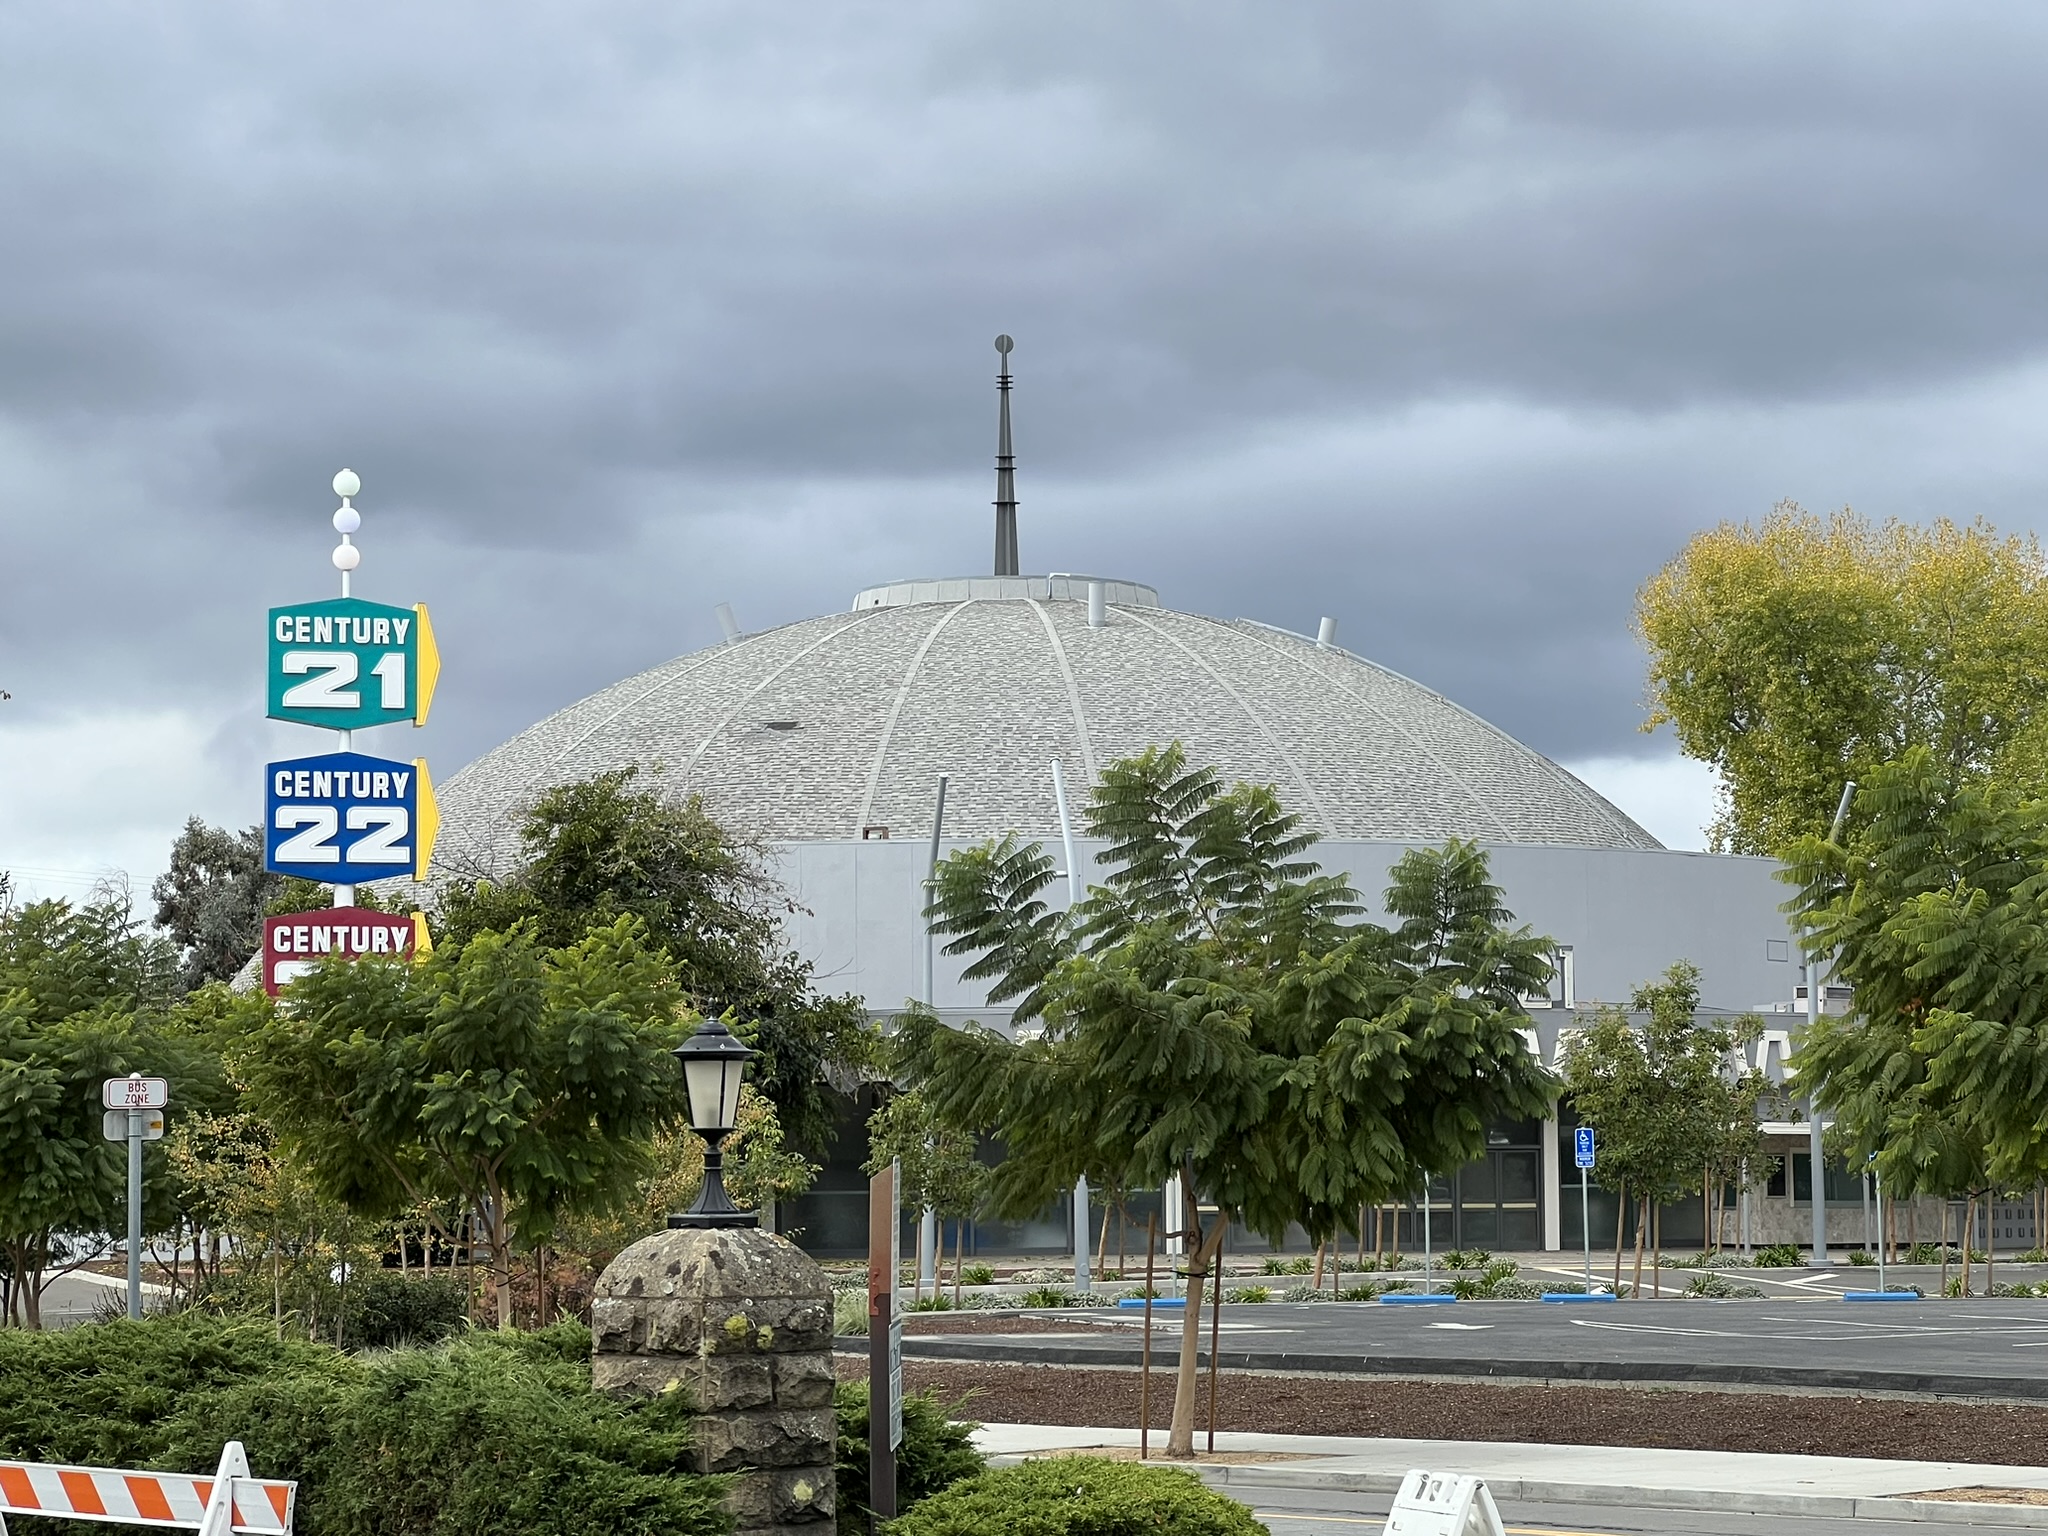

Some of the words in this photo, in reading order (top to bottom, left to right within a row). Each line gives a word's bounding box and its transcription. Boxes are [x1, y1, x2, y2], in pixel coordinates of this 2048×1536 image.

[275, 615, 410, 645] CENTURY
[282, 651, 406, 709] 21
[275, 771, 410, 799] CENTURY
[275, 805, 410, 864] 22
[273, 925, 410, 954] CENTURY
[125, 1093, 150, 1104] ZONE
[128, 1082, 147, 1093] BUS
